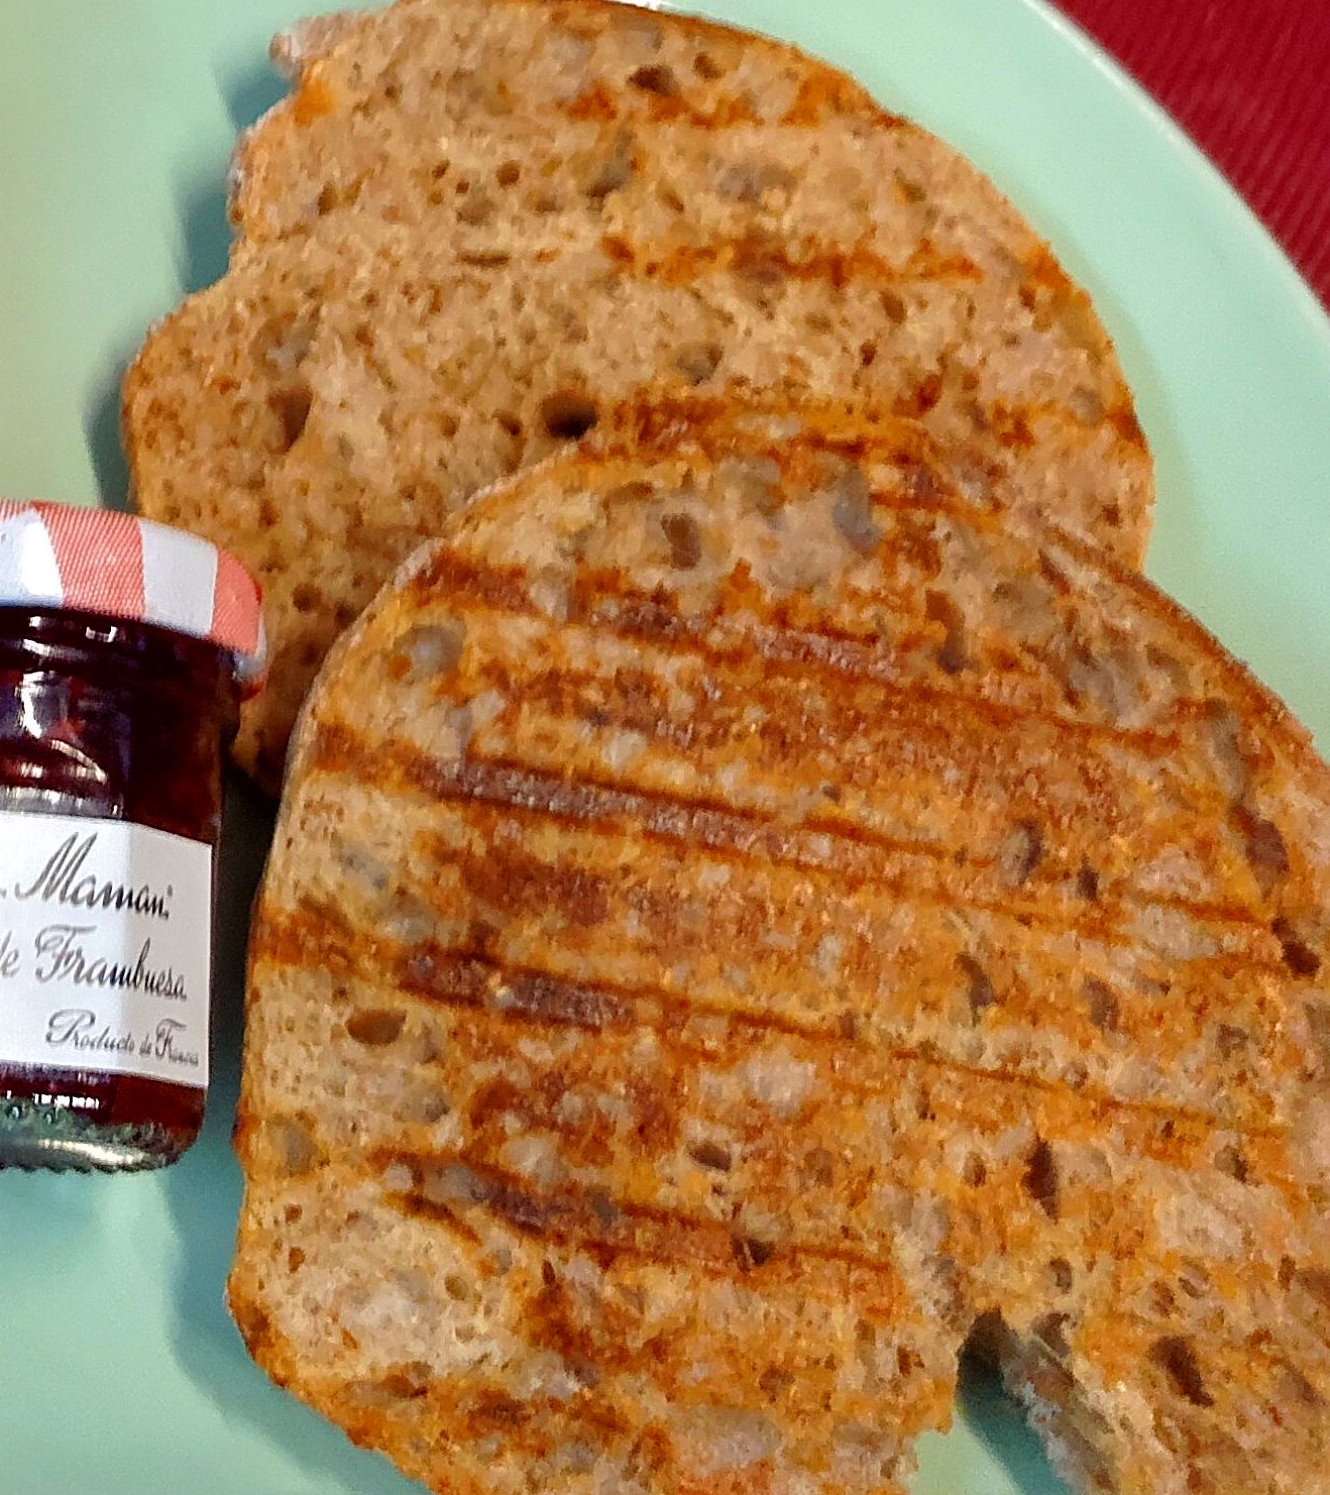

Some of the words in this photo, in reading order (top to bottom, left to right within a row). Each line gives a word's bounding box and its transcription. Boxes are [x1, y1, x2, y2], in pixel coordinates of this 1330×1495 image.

[15, 832, 171, 920] Maman
[35, 924, 188, 1003] Frambuesa
[45, 1009, 136, 1055] Producto
